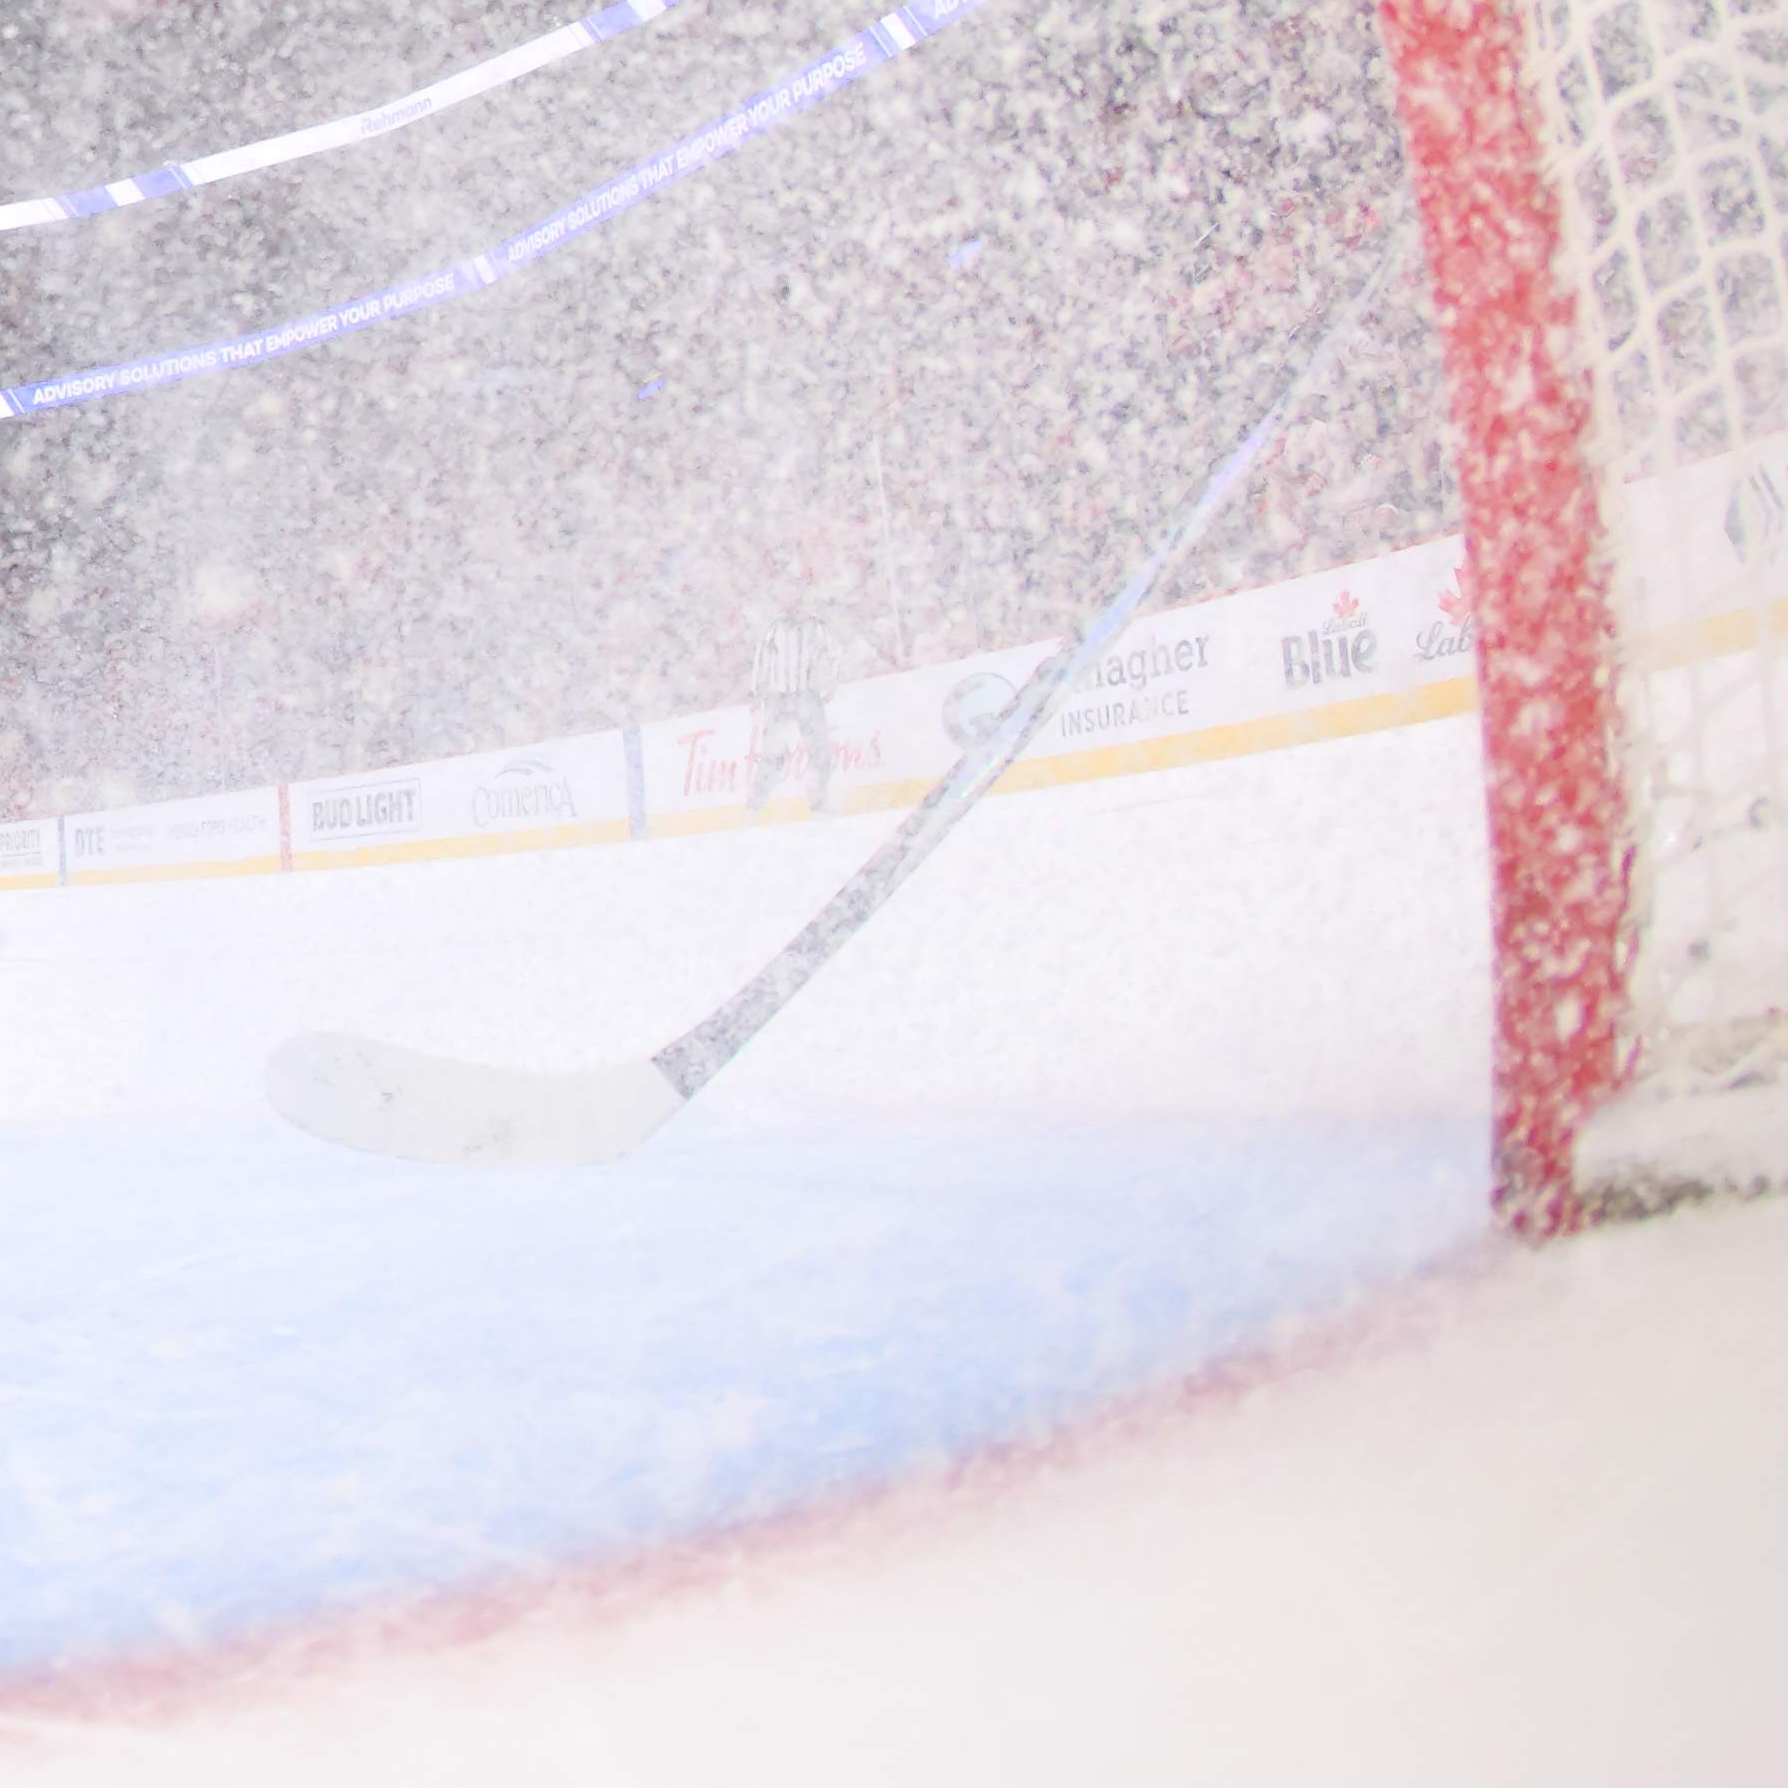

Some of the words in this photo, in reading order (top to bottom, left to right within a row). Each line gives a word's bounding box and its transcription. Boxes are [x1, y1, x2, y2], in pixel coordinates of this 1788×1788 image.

[507, 217, 565, 263] ADVISORY
[639, 154, 675, 192] THAT
[746, 81, 791, 137] YOUR
[792, 42, 868, 103] PURPOSE
[33, 370, 117, 406] ADVISORY
[119, 351, 218, 387] SOLUTIONS
[220, 338, 264, 364] THAT
[264, 313, 339, 351] EMPOWER
[337, 298, 381, 330] YOUR
[381, 273, 455, 315] PURPOSE
[1093, 631, 1211, 690] lagher
[1281, 627, 1379, 689] Blue
[1414, 617, 1473, 663] Lab
[312, 797, 350, 832] BUD
[356, 787, 416, 827] LIGHT
